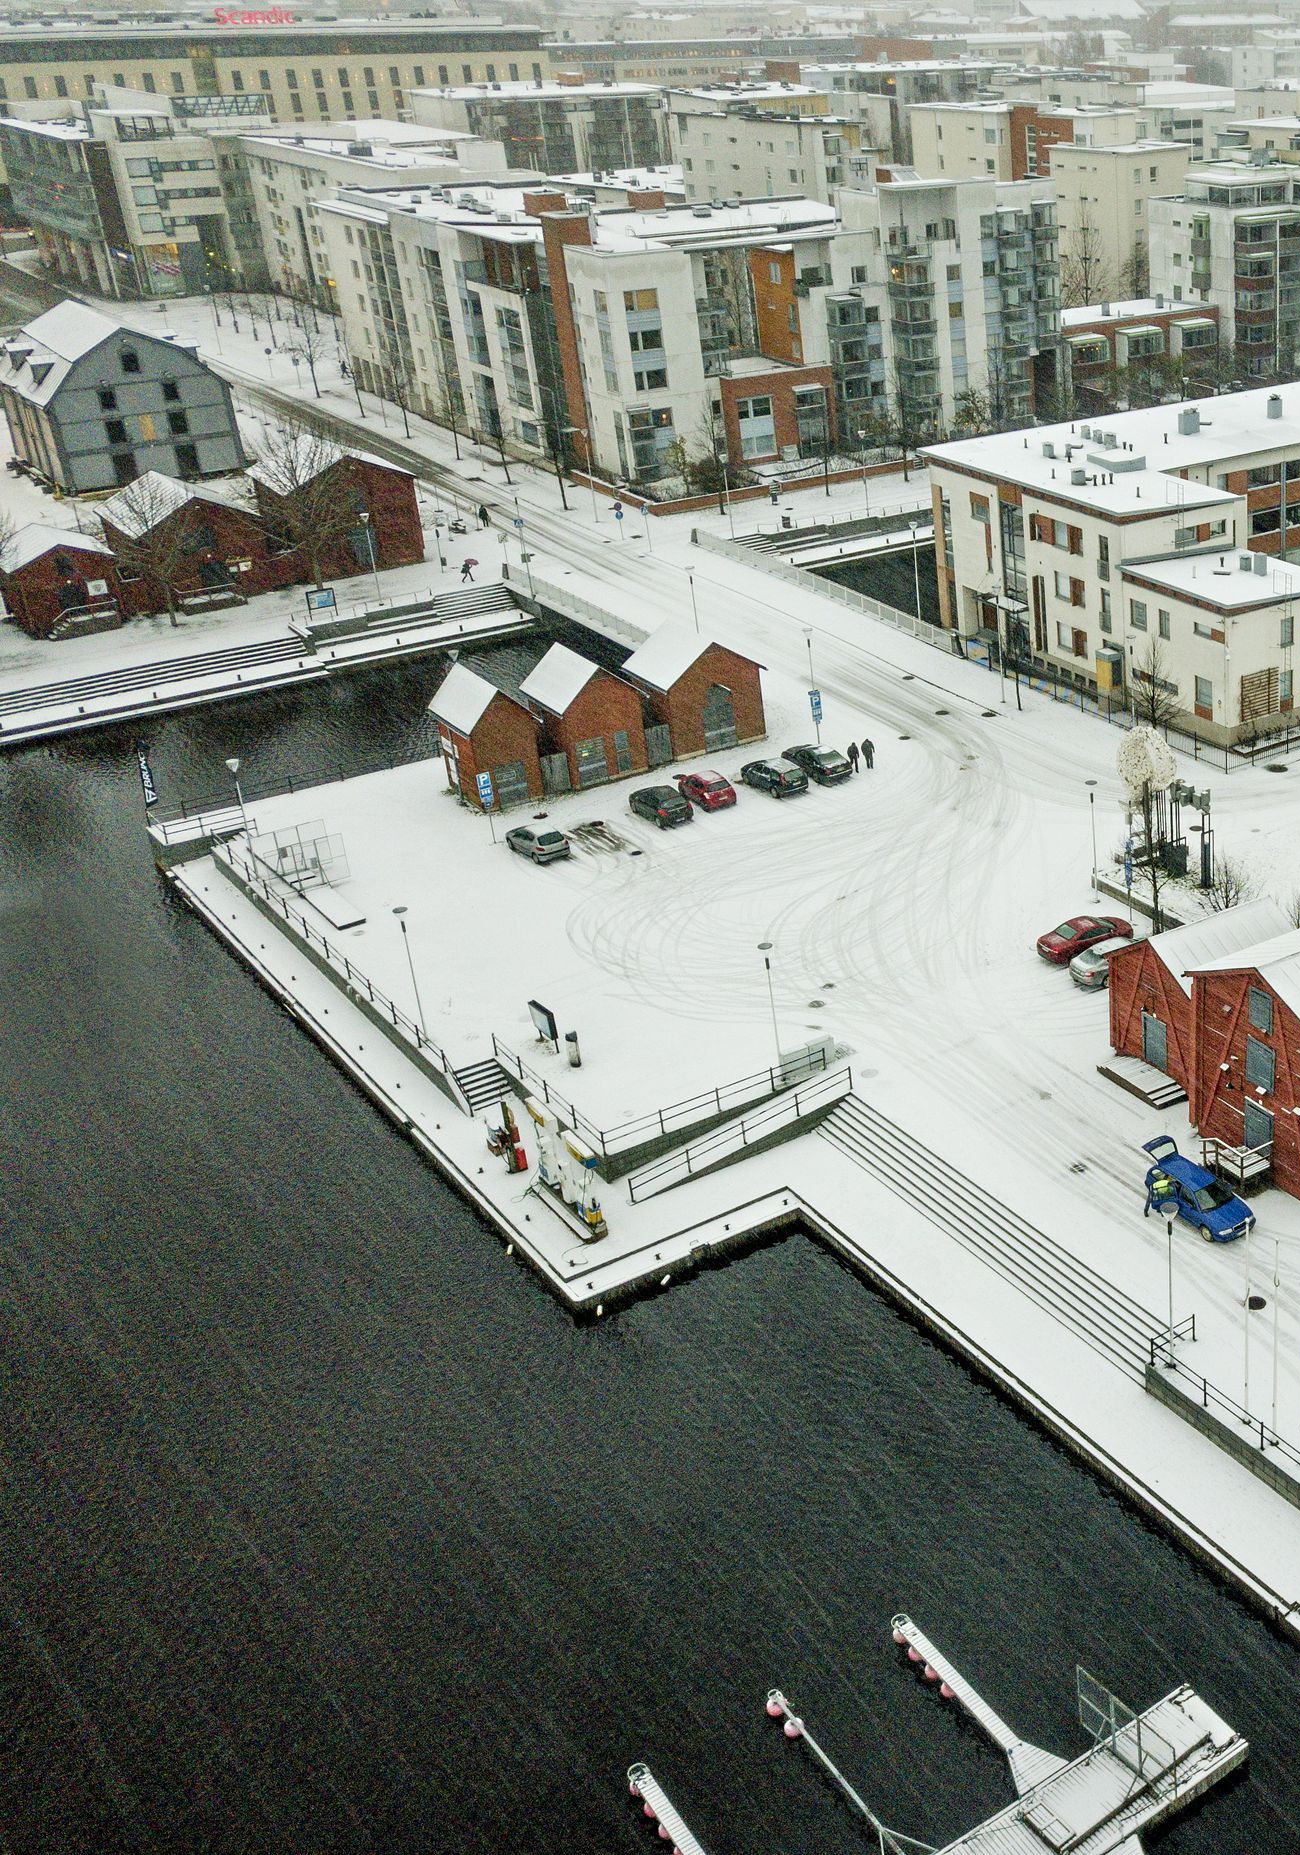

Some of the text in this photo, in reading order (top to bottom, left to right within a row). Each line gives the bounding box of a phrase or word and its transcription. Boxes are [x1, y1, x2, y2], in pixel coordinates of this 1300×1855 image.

[214, 6, 295, 25] Scandic
[812, 696, 819, 706] P
[479, 774, 488, 786] P
